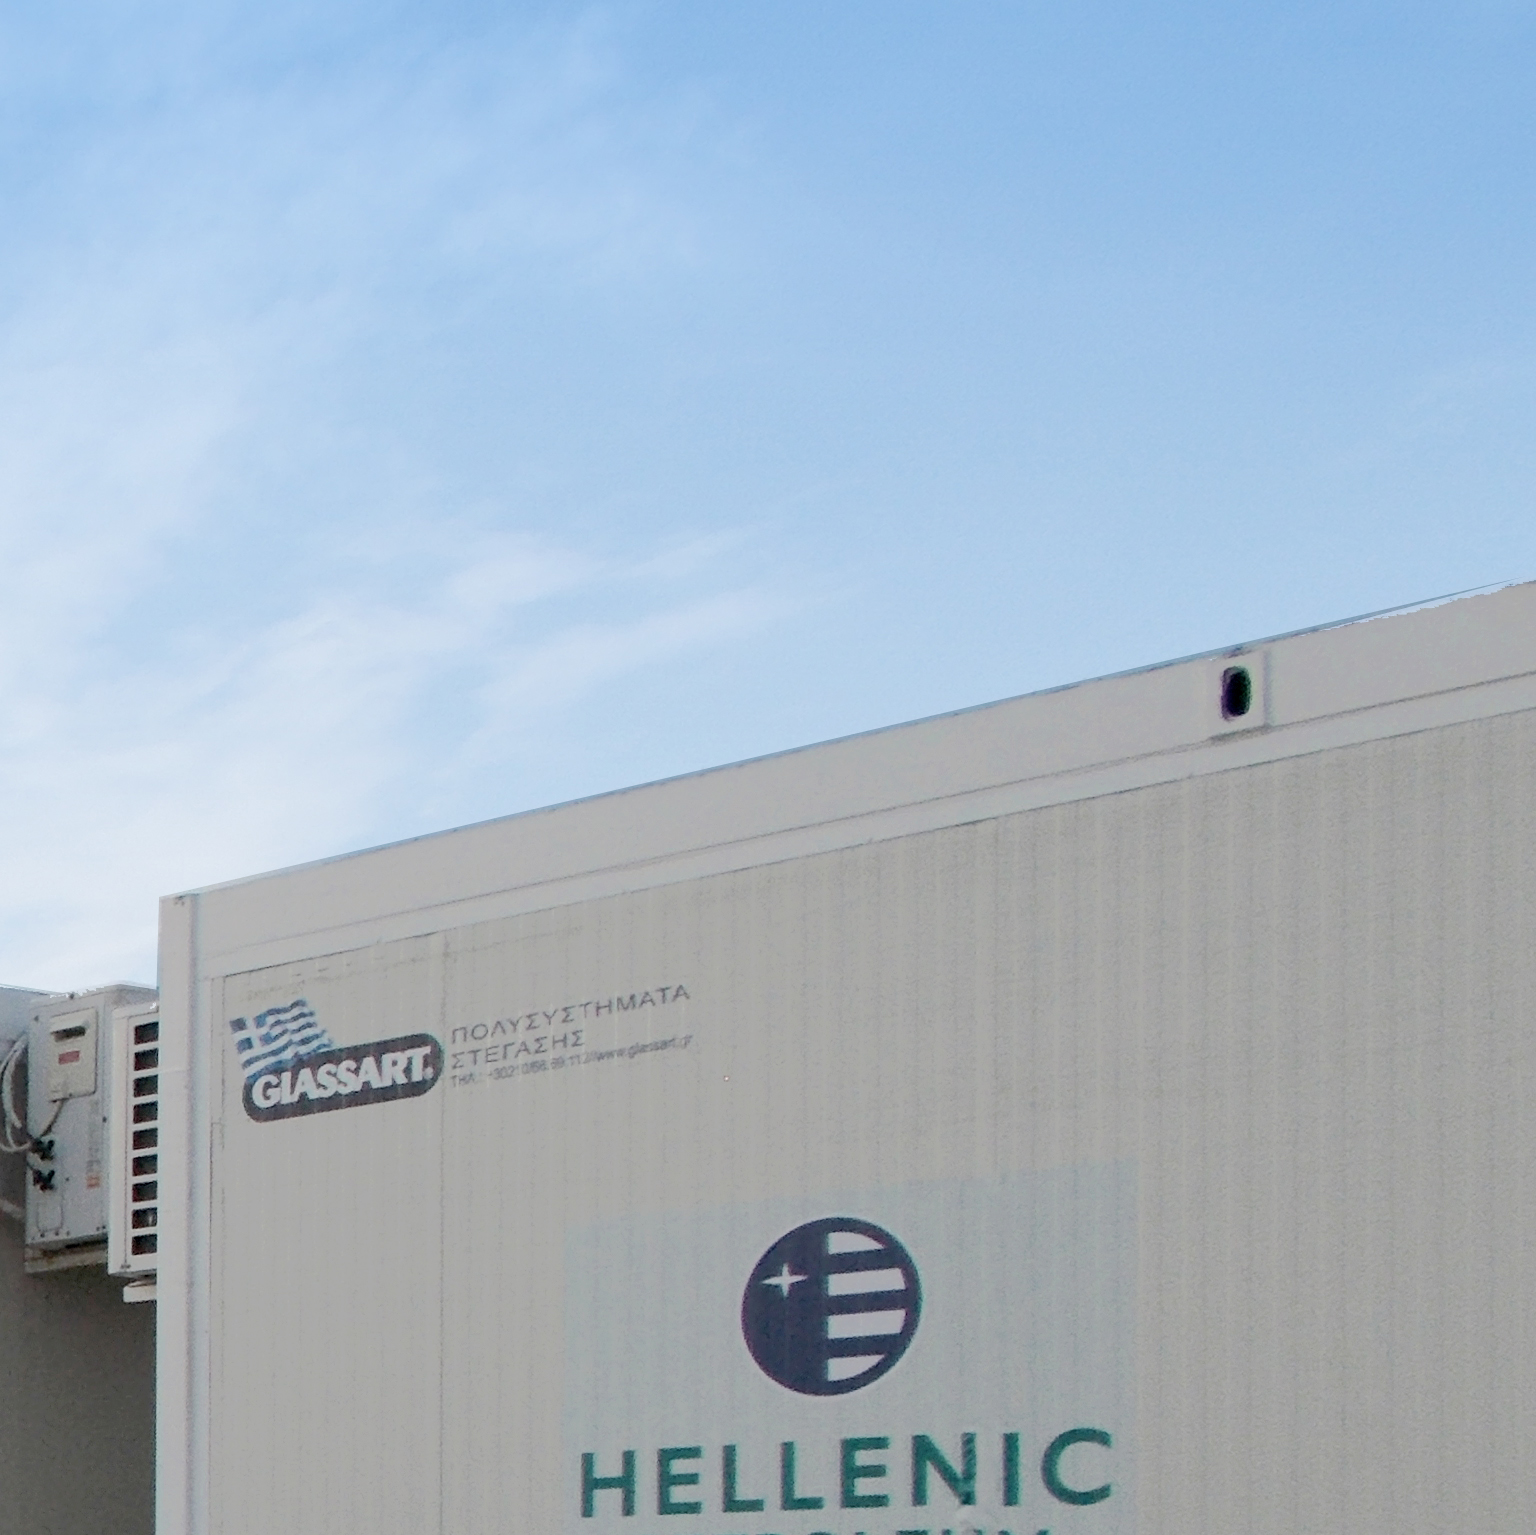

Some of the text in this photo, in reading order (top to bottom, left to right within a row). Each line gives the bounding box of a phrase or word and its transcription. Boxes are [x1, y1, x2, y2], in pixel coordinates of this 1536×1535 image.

[451, 984, 691, 1045] ΠΟΛΥΣΥΣΤΗΜΑΤΑ
[451, 1030, 585, 1069] ΣΤΕΓΑΣΗΣ
[580, 1427, 1116, 1518] HELLENIC
